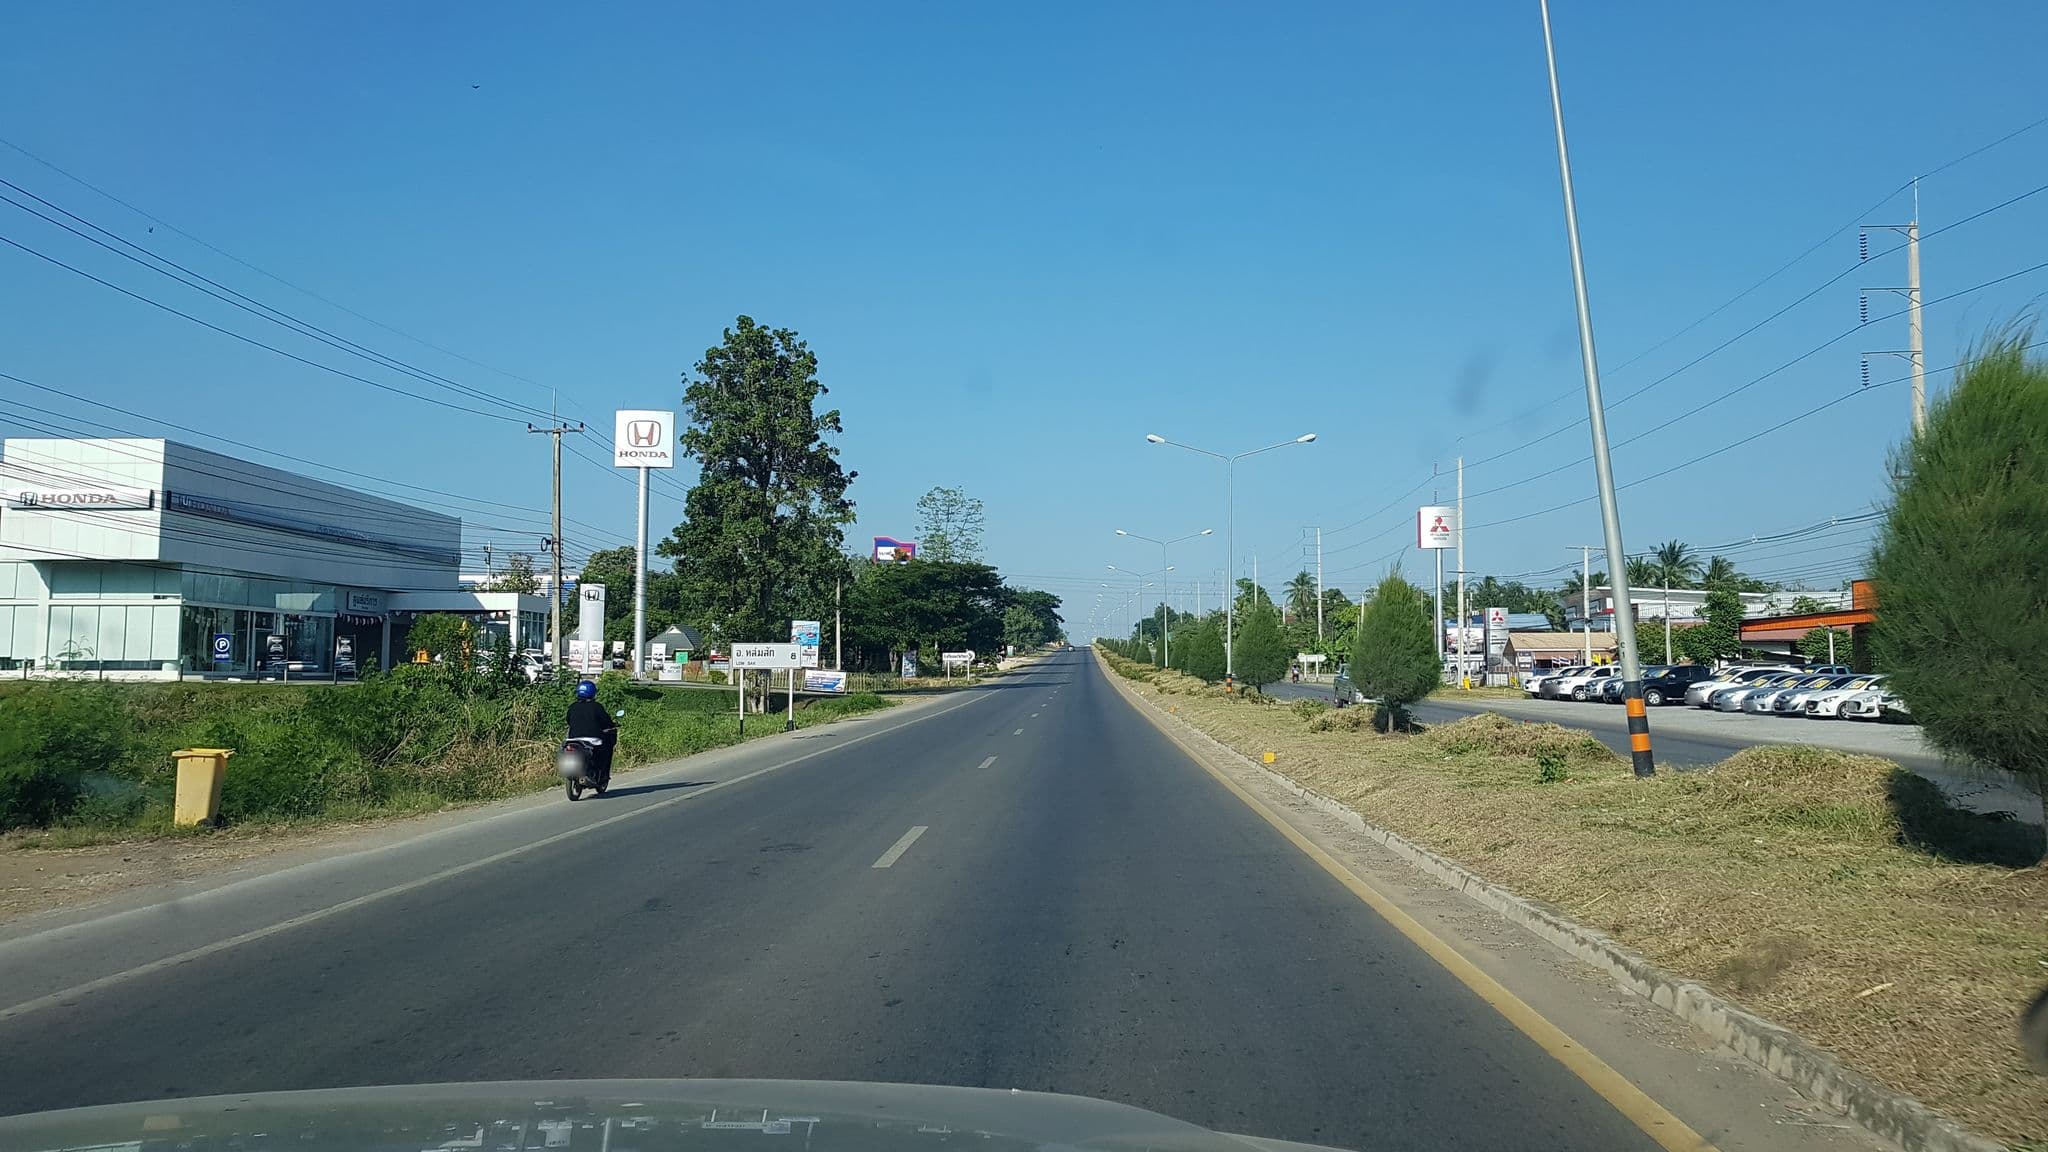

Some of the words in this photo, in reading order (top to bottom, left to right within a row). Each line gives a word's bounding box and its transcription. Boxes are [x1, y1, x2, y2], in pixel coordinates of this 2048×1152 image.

[41, 493, 118, 504] HONDA
[219, 642, 227, 650] P
[746, 646, 775, 657] หล่มสัก
